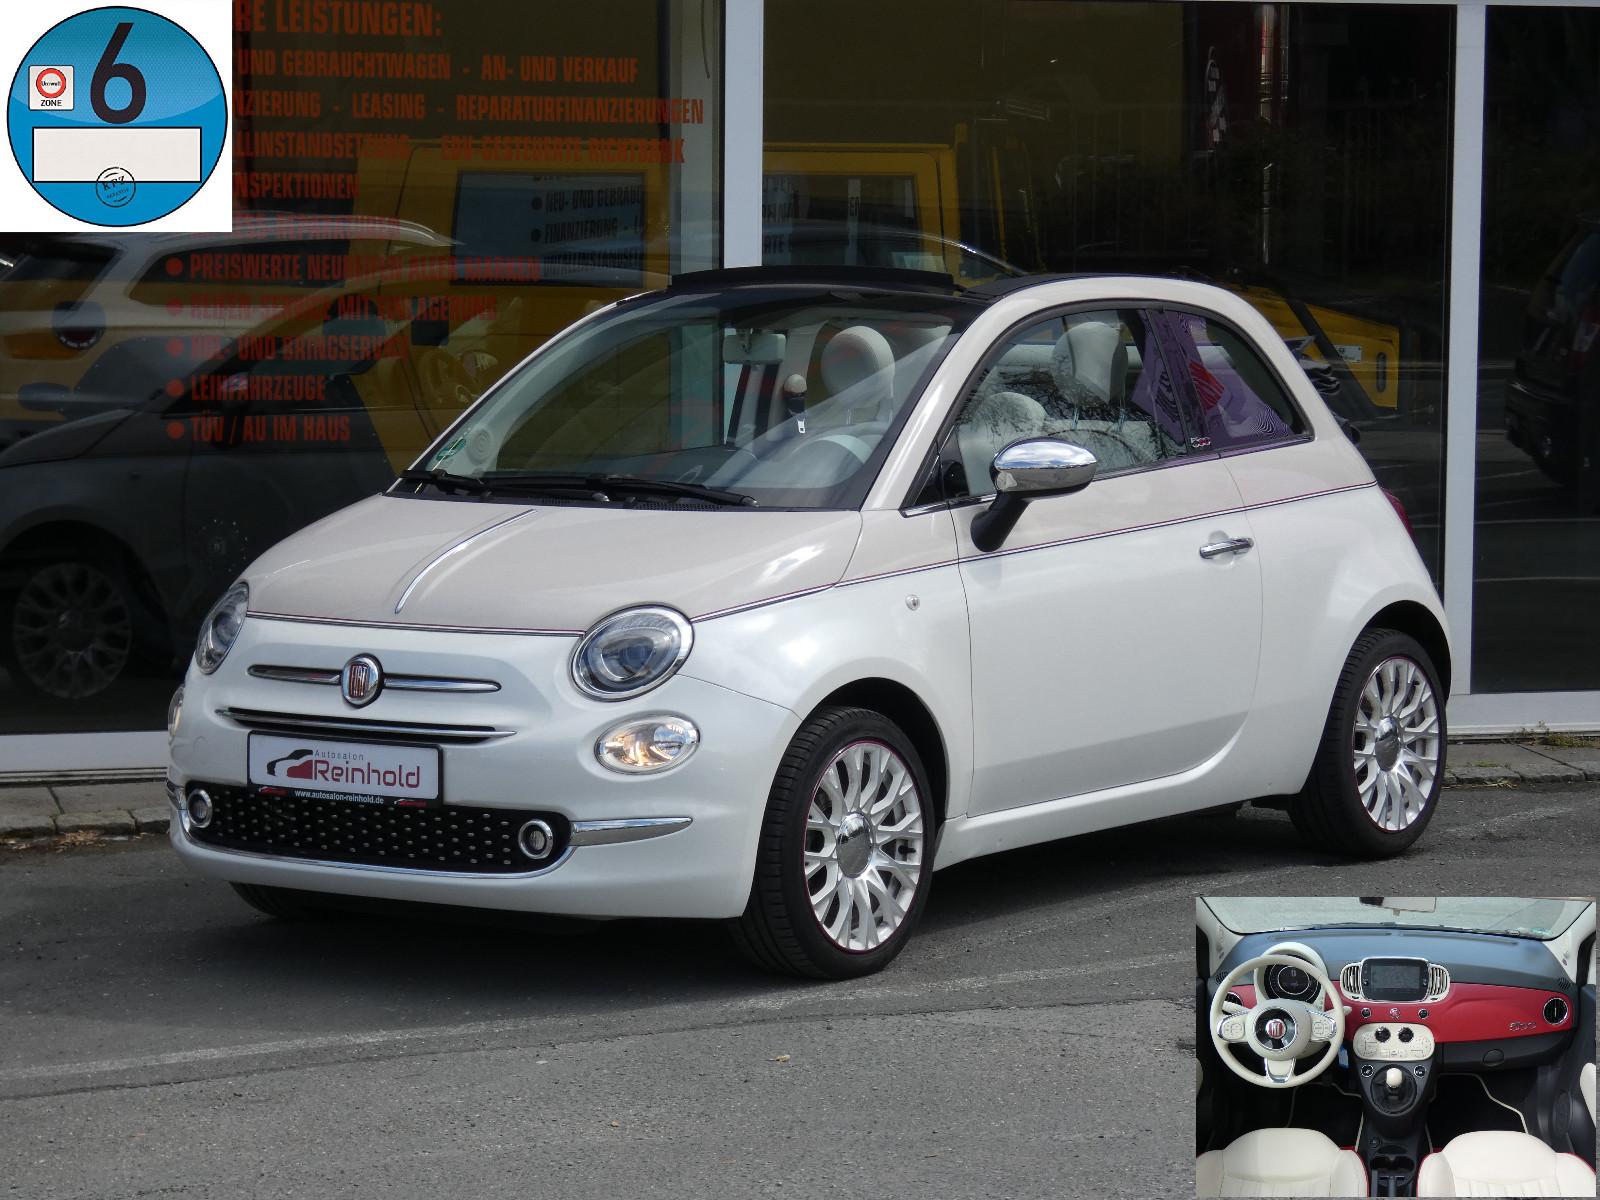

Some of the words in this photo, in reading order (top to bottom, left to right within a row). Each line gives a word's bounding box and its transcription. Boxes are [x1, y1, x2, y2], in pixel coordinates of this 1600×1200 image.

[276, 0, 443, 37] LEISTUNGEN:
[282, 50, 451, 79] GEBRAUCHTWAGEN
[519, 55, 556, 81] UND
[562, 56, 639, 83] VERKAUF
[352, 92, 427, 120] LEASING
[456, 95, 704, 124] REPARATURFINANZIERUNGEN
[191, 254, 301, 281] PREISWERTE
[338, 295, 371, 320] MIT
[238, 335, 277, 361] UND
[242, 415, 267, 441] AU
[272, 415, 297, 441] IM
[303, 415, 350, 441] HAUS
[314, 750, 364, 761] Autosalon
[314, 760, 420, 788] Reinhold
[294, 790, 384, 804] www.autosalon-reinhold.de
